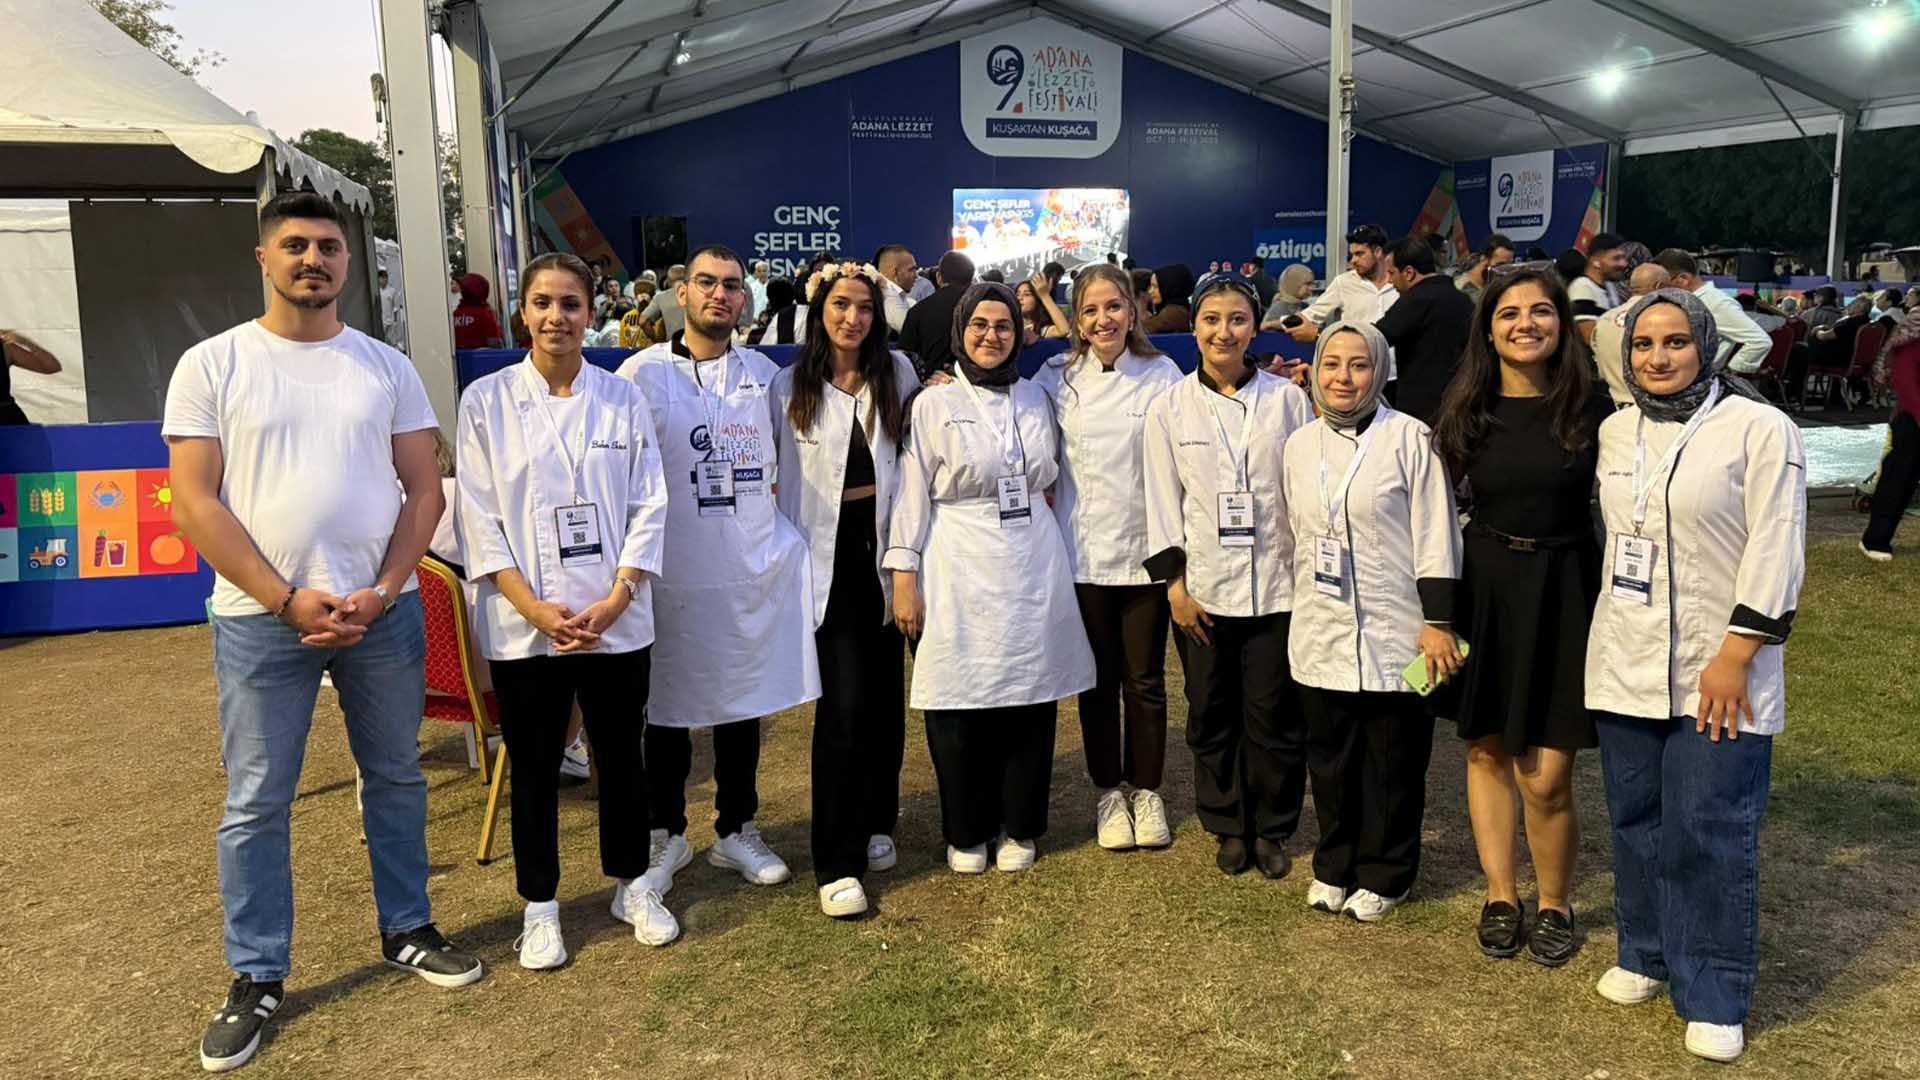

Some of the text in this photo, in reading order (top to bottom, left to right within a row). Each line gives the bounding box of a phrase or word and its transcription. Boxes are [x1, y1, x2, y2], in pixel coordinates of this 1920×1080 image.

[1033, 46, 1092, 71] ADANA
[1037, 69, 1090, 92] LEZZET
[851, 121, 933, 132] ADANA LEZZET
[773, 205, 840, 230] GENÇ
[754, 231, 841, 257] ŞEFLER
[1256, 238, 1325, 263] öztirya
[455, 313, 474, 327] KİP
